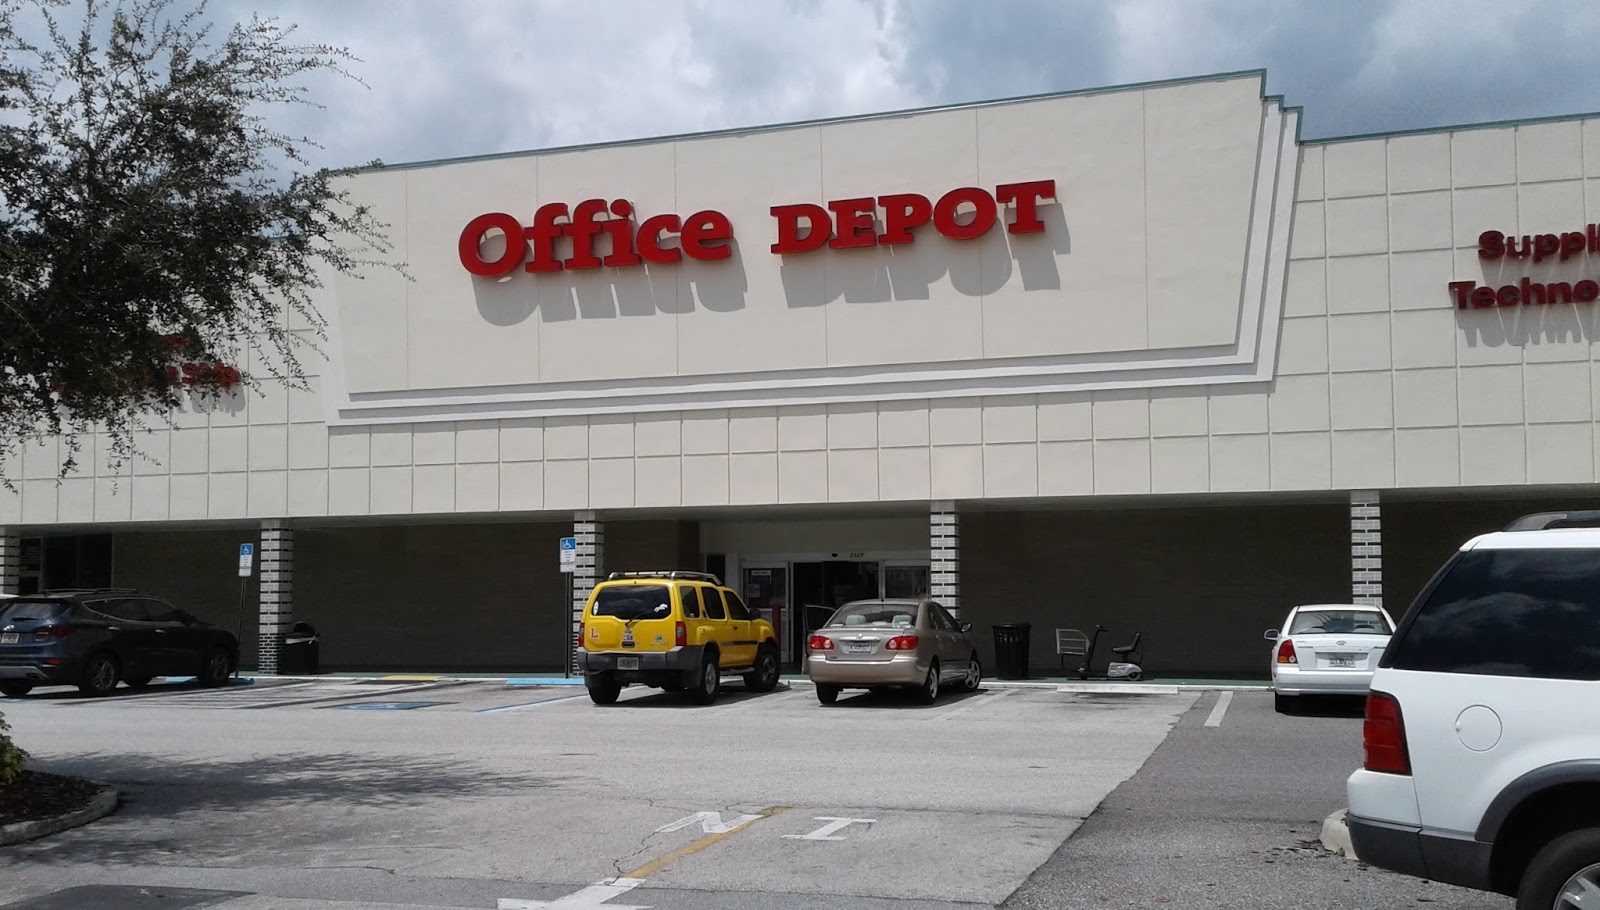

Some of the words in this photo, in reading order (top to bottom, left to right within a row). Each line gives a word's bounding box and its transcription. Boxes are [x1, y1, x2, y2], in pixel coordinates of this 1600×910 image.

[458, 198, 734, 277] Office
[770, 179, 1056, 254] DEPOT
[1478, 223, 1600, 263] Suppl
